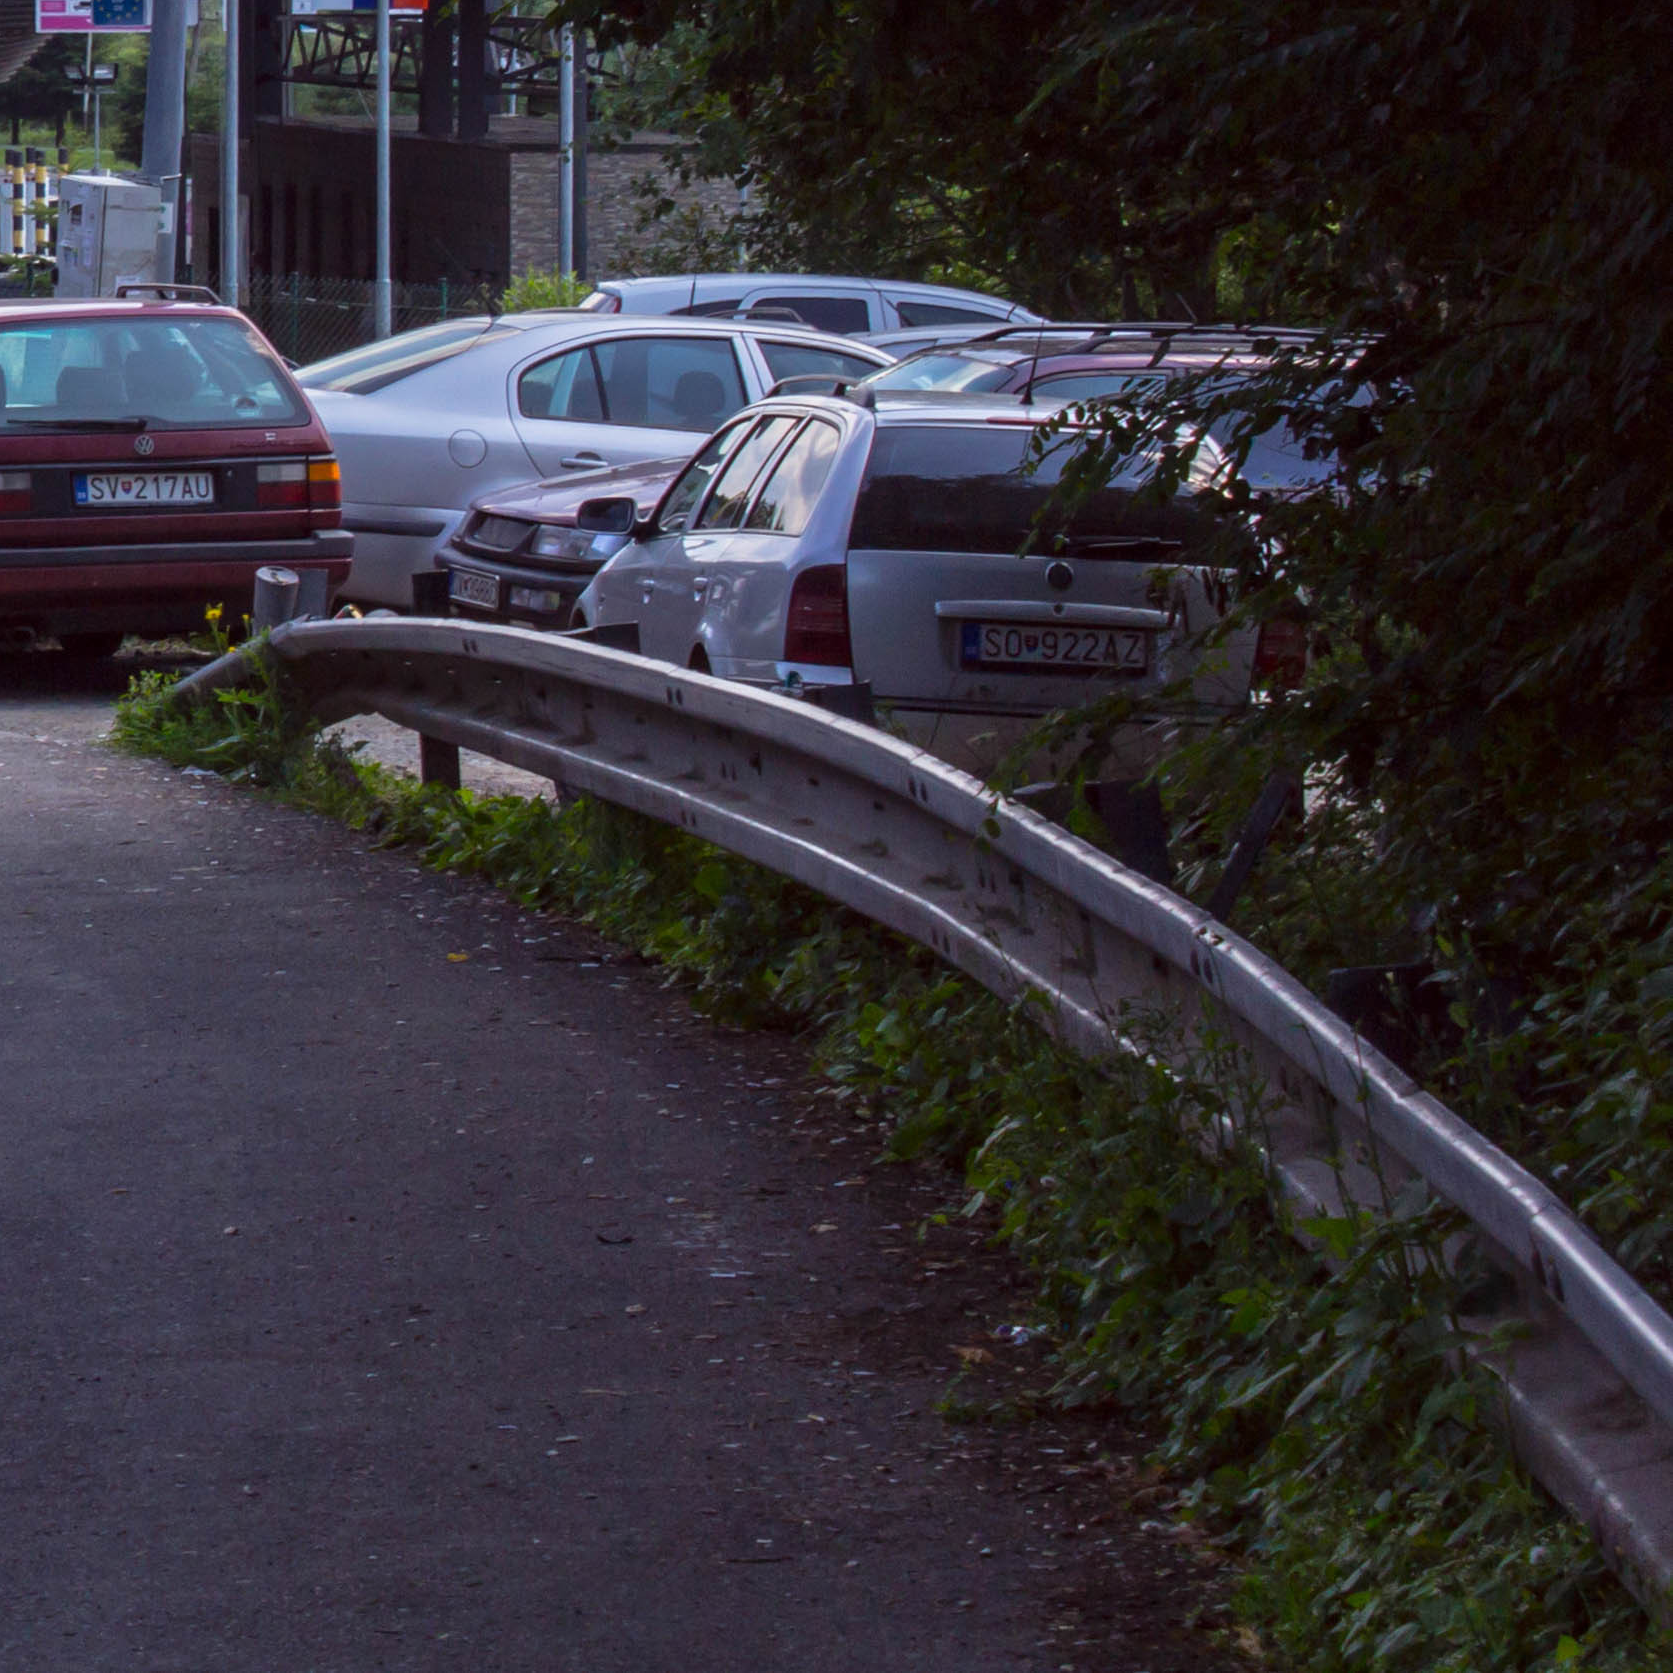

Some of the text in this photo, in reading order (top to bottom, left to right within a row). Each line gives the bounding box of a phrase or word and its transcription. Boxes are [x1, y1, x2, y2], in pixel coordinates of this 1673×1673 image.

[90, 476, 210, 500] SV 217AU
[1041, 630, 1141, 664] 922AZ
